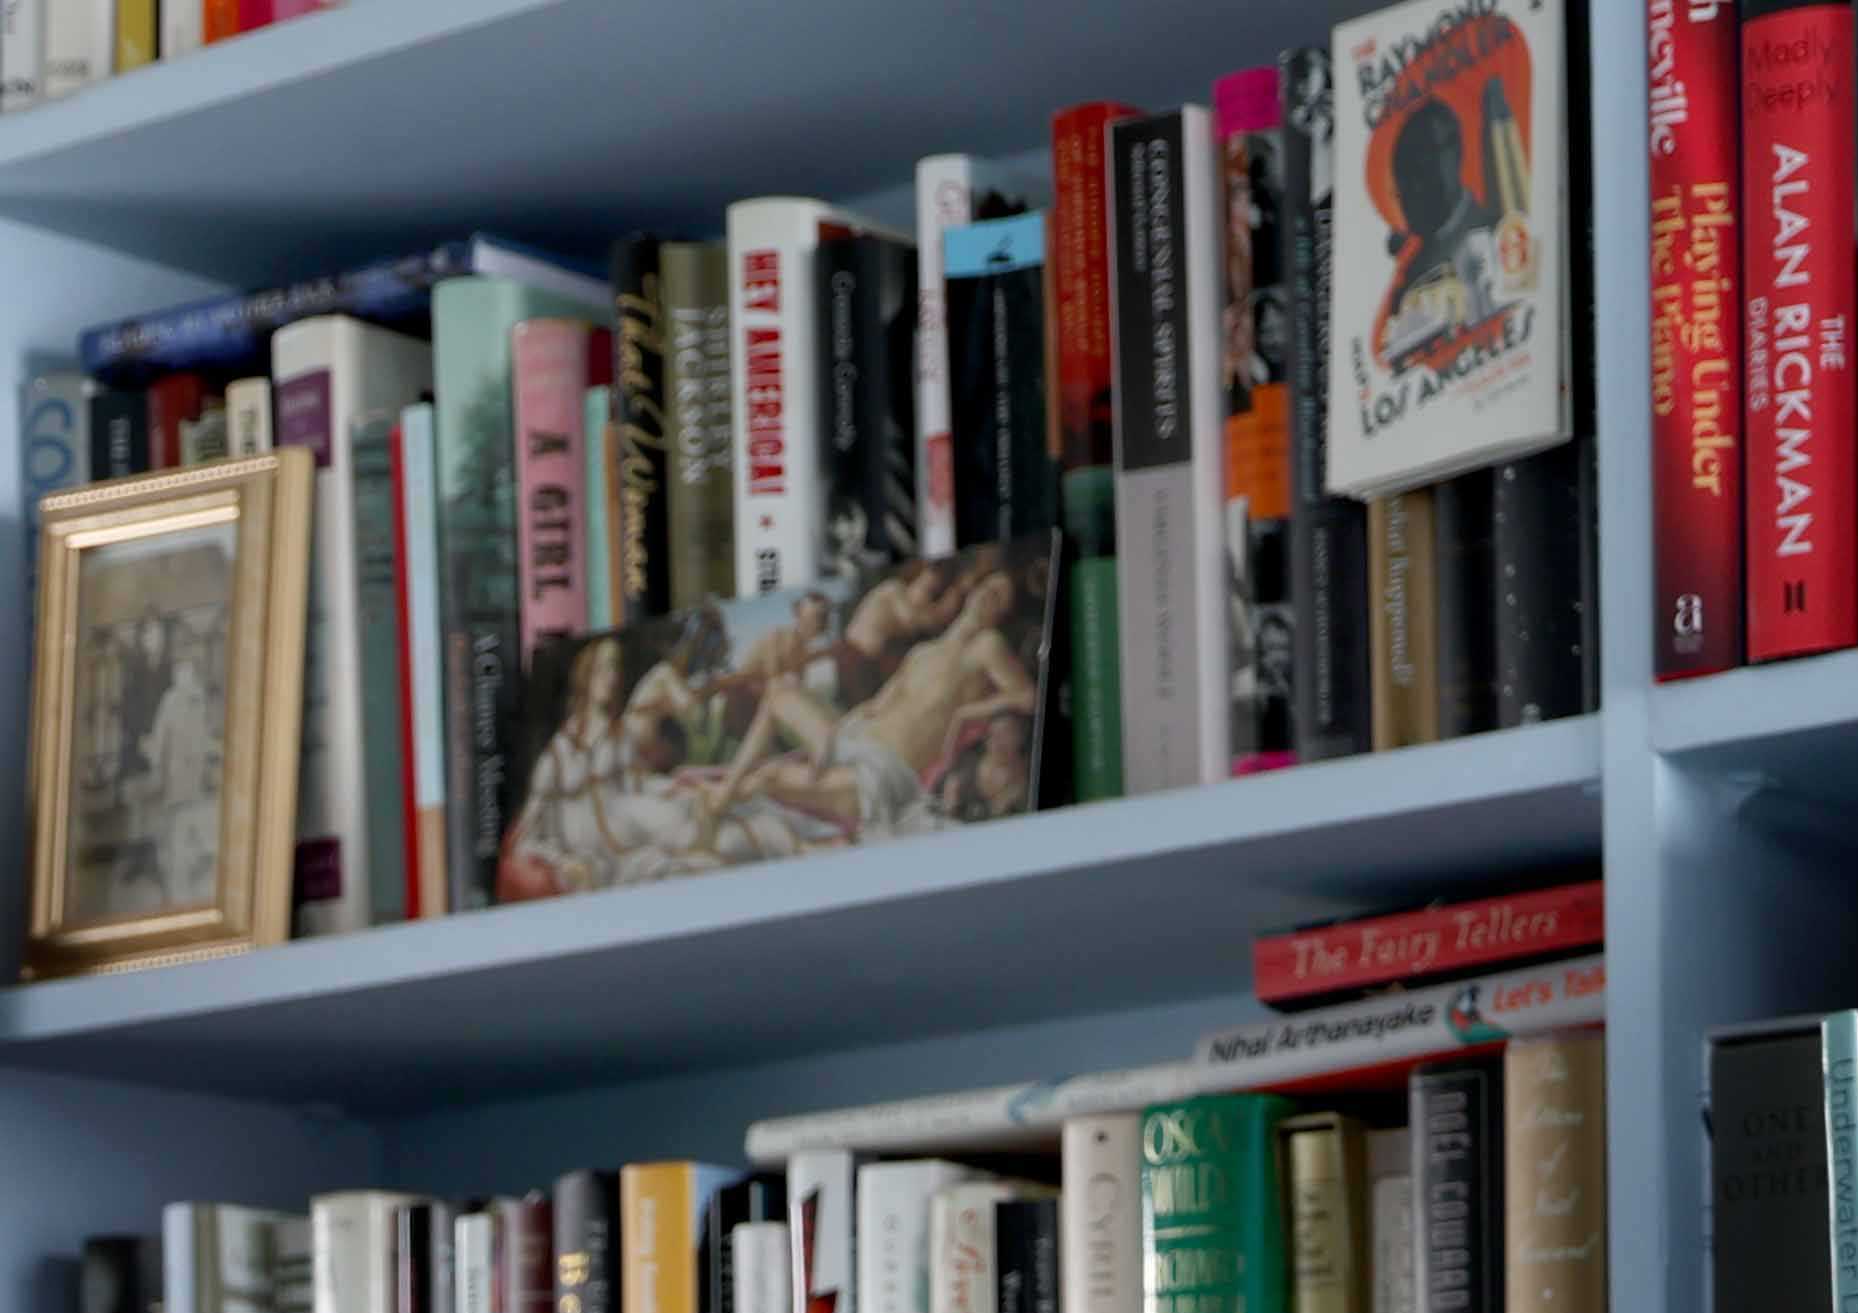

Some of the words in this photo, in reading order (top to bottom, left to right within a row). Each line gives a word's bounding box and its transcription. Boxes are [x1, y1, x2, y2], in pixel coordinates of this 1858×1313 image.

[1653, 184, 1682, 278] The
[1684, 182, 1734, 354] Playing
[1772, 142, 1809, 289] ALAN
[1416, 306, 1536, 406] ANGELES
[1749, 298, 1769, 411] DIARIES
[1819, 314, 1846, 370] THE
[1692, 357, 1736, 495] Under
[1774, 303, 1816, 556] RICKMAN
[1287, 937, 1346, 979] The
[1358, 925, 1441, 973] Fairy
[1452, 904, 1560, 951] Tellers
